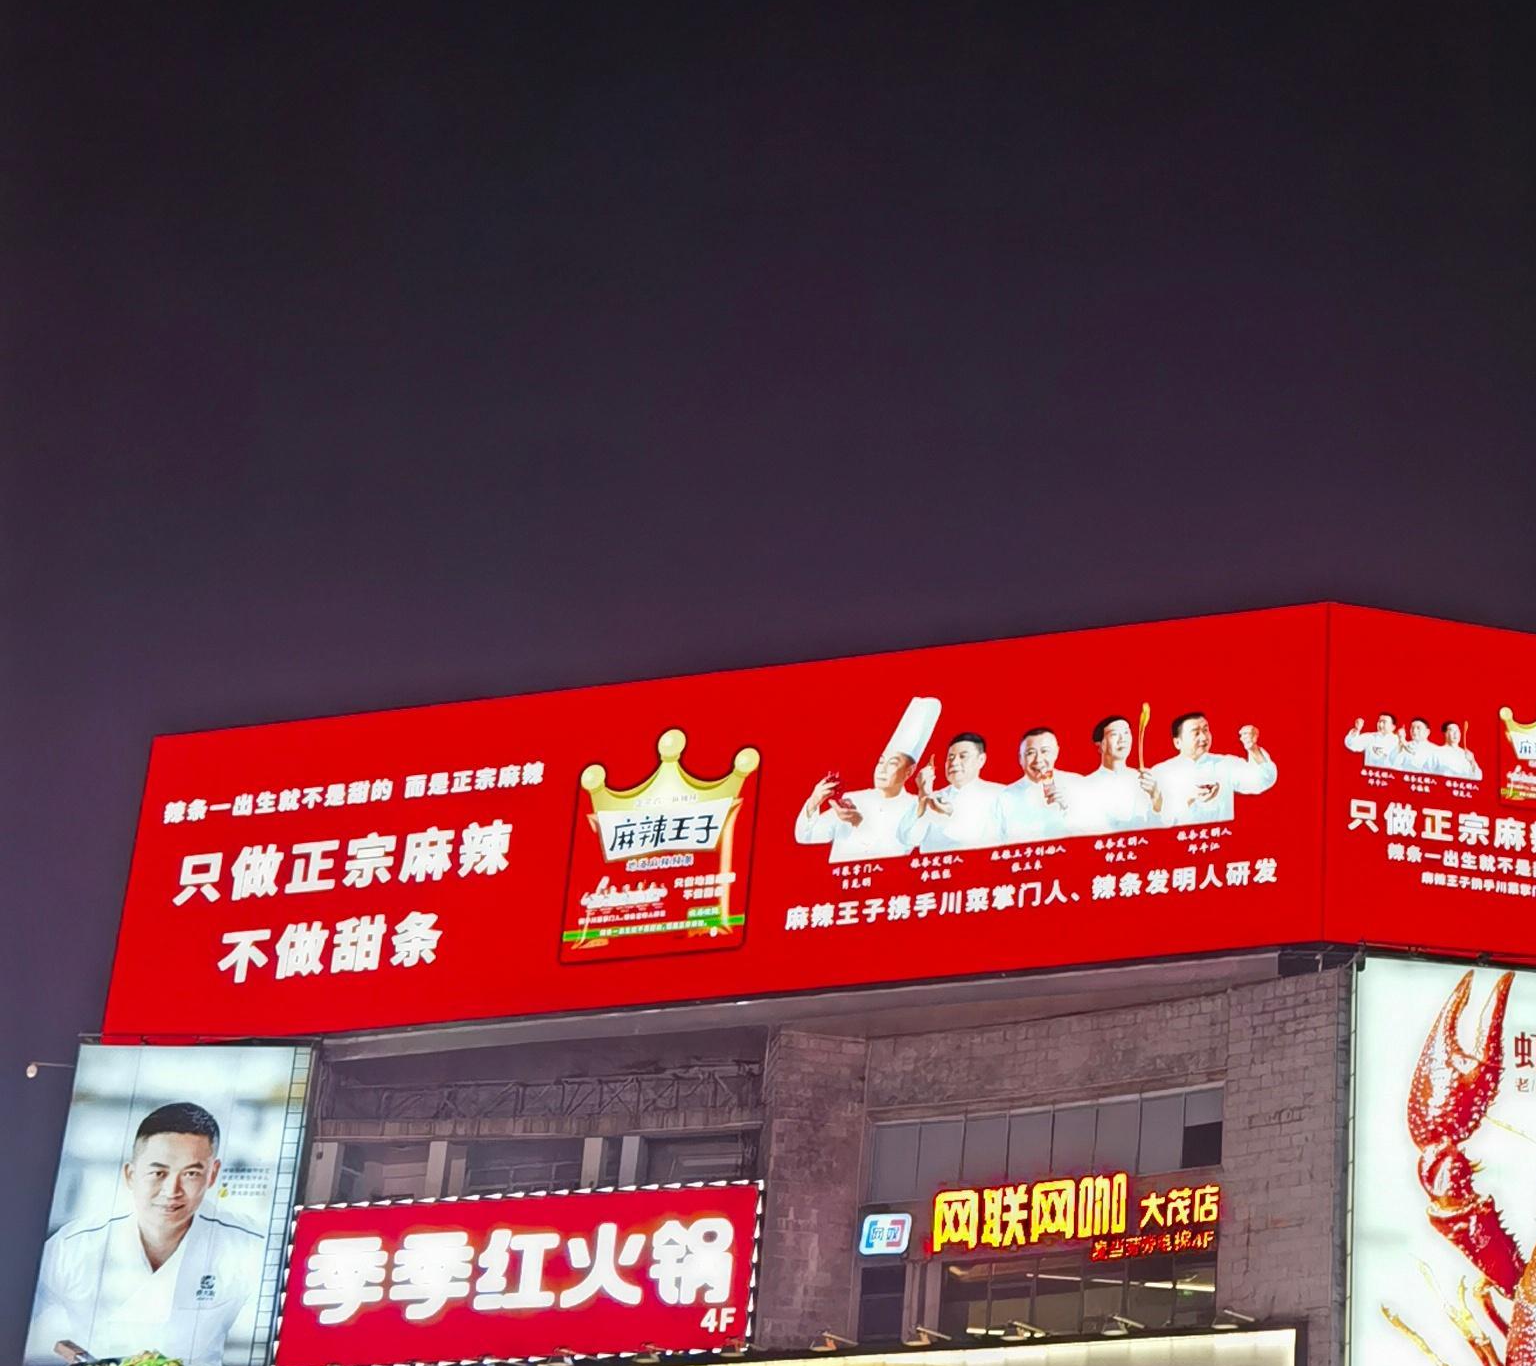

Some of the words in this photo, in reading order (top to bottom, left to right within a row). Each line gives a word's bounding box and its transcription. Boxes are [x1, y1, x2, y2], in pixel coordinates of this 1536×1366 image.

[163, 779, 393, 824] 辣条一出生就不是甜的
[404, 761, 544, 799] 而是正宗麻辣
[172, 819, 513, 906] 只做正宗麻辣
[609, 814, 719, 852] 麻辣王子
[785, 857, 1278, 931] 麻辣王子携手川菜掌门人、辣条发明人研发
[217, 911, 444, 984] 不做甜条
[932, 1172, 1129, 1252] 网联网咖
[1139, 1185, 1221, 1229] 大茂店
[303, 1217, 735, 1325] 季季红火锅
[700, 1307, 738, 1334] 4F
